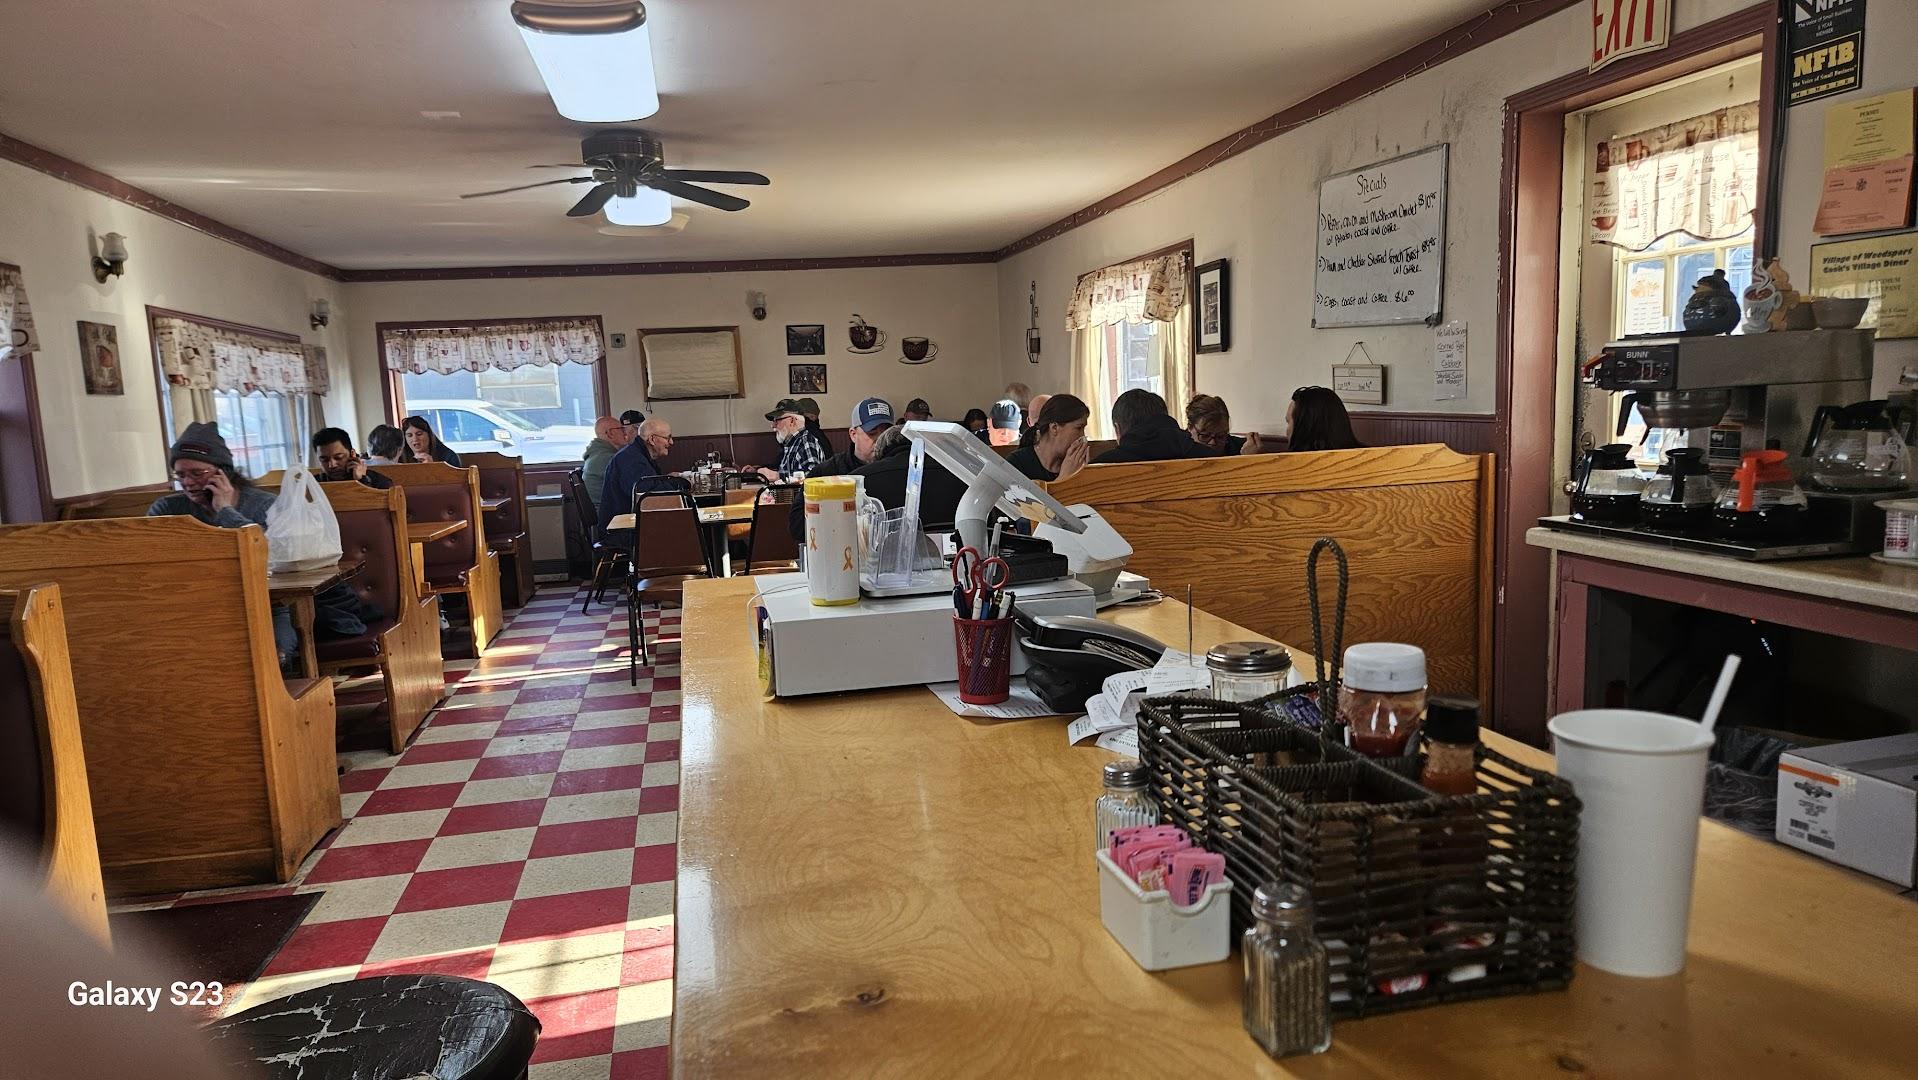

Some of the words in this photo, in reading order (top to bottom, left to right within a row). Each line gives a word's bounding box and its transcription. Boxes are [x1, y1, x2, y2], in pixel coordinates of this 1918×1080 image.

[1793, 41, 1855, 78] NFIB
[1823, 255, 1851, 265] Village
[1852, 261, 1882, 271] Village
[1883, 259, 1910, 268] Diner
[1626, 351, 1649, 359] BUNN
